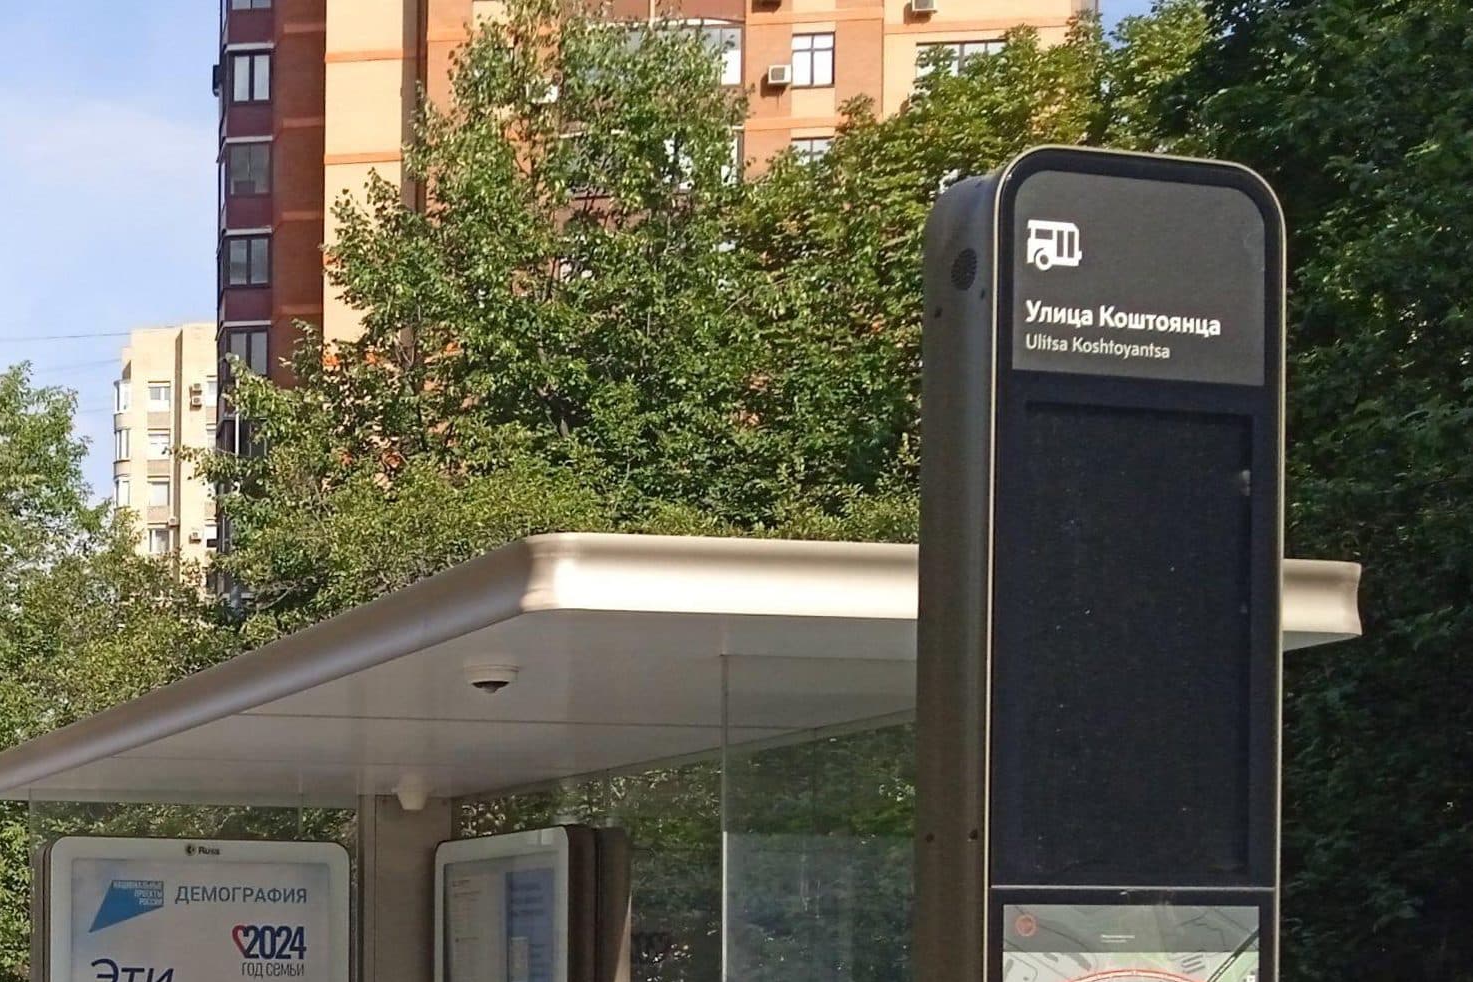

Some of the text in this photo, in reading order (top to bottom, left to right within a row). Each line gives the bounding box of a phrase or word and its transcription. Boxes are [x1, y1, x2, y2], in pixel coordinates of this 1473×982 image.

[1025, 300, 1222, 338] Улица Коштоянца
[1026, 333, 1171, 360] Ulitsa Koshtoyantsa
[174, 885, 308, 904] ДЕМОГРАФИЯ
[242, 925, 307, 960] 2024
